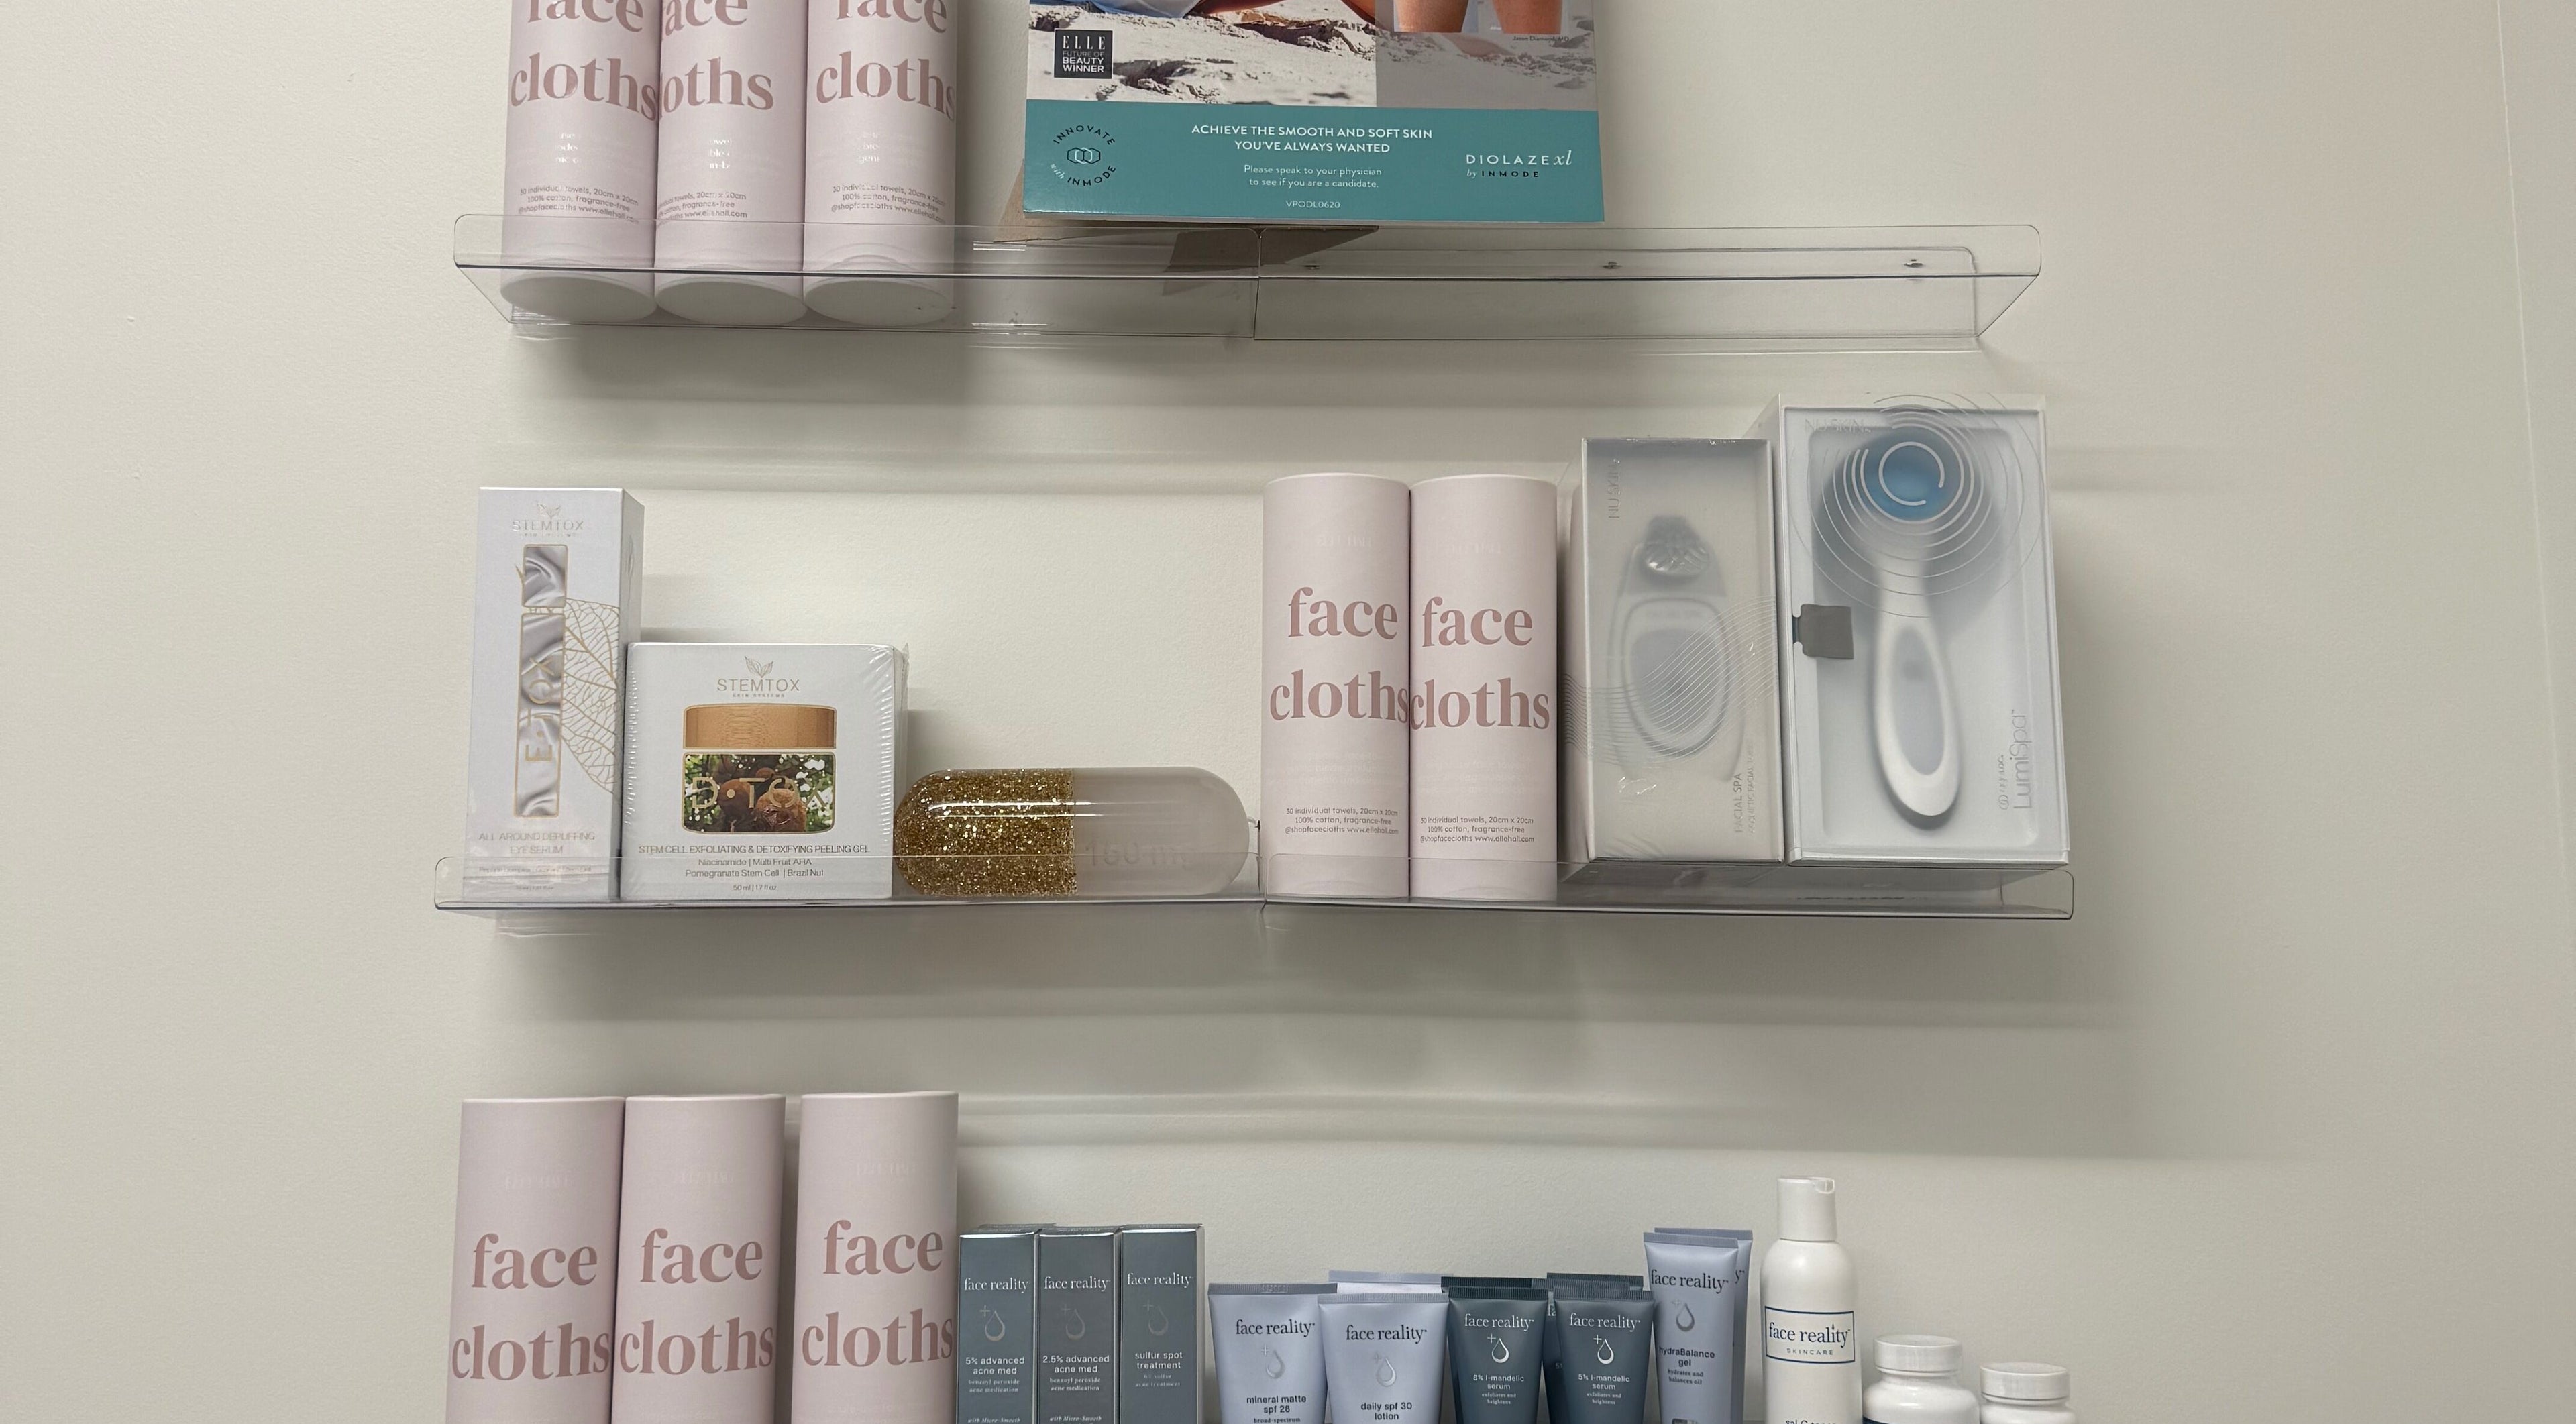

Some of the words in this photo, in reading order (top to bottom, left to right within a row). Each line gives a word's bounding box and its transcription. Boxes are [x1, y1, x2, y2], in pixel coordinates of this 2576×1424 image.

[664, 0, 748, 36] ace
[1063, 35, 1106, 50] ELLE
[1063, 57, 1104, 65] BEAUTY
[1063, 65, 1104, 73] WINNER
[511, 52, 657, 121] cloths
[660, 56, 774, 117] oths
[816, 51, 955, 121] cloths
[1053, 125, 1115, 146] INNOVATE
[1191, 125, 1248, 135] ACHIEVE
[1250, 126, 1275, 135] THE
[1278, 127, 1334, 137] SMOOTH
[1337, 127, 1365, 138] AND
[1368, 129, 1401, 138] SOFT
[1403, 129, 1433, 139] SKIN
[1234, 140, 1281, 150] YOU'VE
[1283, 142, 1333, 152] ALWAYS
[1336, 142, 1391, 152] WANTED
[1067, 165, 1116, 186] INMODE
[1244, 164, 1273, 174] Please
[1275, 166, 1301, 176] speak
[1316, 168, 1337, 177] your
[1339, 166, 1382, 178] physician
[1466, 169, 1477, 179] by
[1279, 178, 1286, 186] if
[1288, 179, 1305, 188] you
[1332, 178, 1379, 188] candidate.
[726, 192, 747, 200] 20cm
[1285, 200, 1340, 209] VPODL0620
[1608, 498, 1620, 518] NU
[511, 519, 584, 531] STEMTOX
[1287, 586, 1398, 640] face
[1421, 596, 1532, 648] face
[716, 678, 800, 692] STEMTOX
[1269, 669, 1408, 723] cloths
[1410, 677, 1550, 730] cloths
[2009, 714, 2033, 809] LumiSpa
[1733, 773, 1743, 793] SPA
[1332, 807, 1358, 815] towels,
[1733, 796, 1743, 833] FACIAL
[1314, 816, 1342, 824] cotton,
[1344, 817, 1392, 826] fragrance-free
[1460, 816, 1487, 824] towels,
[498, 832, 541, 841] AROUND
[1285, 826, 1345, 834] @shopfacecloths
[1346, 826, 1399, 835] www.ellehall.com
[1444, 826, 1470, 834] cotton,
[1472, 826, 1525, 834] fragrance-free
[1420, 835, 1472, 843] @shopfacecloths
[1474, 835, 1535, 843] www.ellehall.com
[529, 845, 564, 855] SERUM
[639, 845, 663, 854] STEM
[665, 845, 688, 854] CELL
[689, 845, 746, 854] EXFOLIATING
[748, 845, 754, 854] &
[756, 844, 813, 854] DETOXIFYING
[814, 845, 851, 854] PEELING
[853, 845, 870, 854] GEL
[1085, 840, 1139, 867] 150
[698, 858, 747, 866] Niacinamide
[753, 858, 771, 866] Multi
[773, 858, 790, 866] Fruit
[792, 858, 812, 866] AHA
[686, 869, 739, 879] Pomegranate
[741, 869, 762, 877] Stem
[764, 869, 780, 877] Cell
[787, 869, 808, 877] Brazil
[810, 869, 824, 877] Nut
[822, 1219, 943, 1275] face
[471, 1233, 598, 1289] face
[640, 1227, 763, 1284] face
[965, 1277, 987, 1291] face
[991, 1277, 1028, 1293] reality
[1044, 1276, 1068, 1289] face
[1127, 1272, 1150, 1285] face
[1651, 1269, 1676, 1286] face
[1680, 1273, 1725, 1294] reality
[1236, 1319, 1263, 1335] face
[1266, 1319, 1313, 1337] reality
[1464, 1313, 1489, 1327] face
[1492, 1314, 1530, 1331] reality
[1570, 1312, 1595, 1327] face
[1597, 1314, 1638, 1332] reality
[802, 1307, 953, 1368] cloths
[1346, 1324, 1375, 1341] face
[1378, 1324, 1424, 1344] reality
[1769, 1322, 1795, 1341] face
[1799, 1323, 1848, 1348] reality
[452, 1322, 610, 1381] cloths
[619, 1316, 774, 1376] cloths
[1658, 1345, 1715, 1358] hydraBalance
[1786, 1348, 1833, 1356] SKINCARE
[966, 1357, 978, 1365] 5%
[981, 1356, 1025, 1364] advanced
[1042, 1355, 1063, 1363] 2.5%
[1066, 1355, 1110, 1363] advanced
[1135, 1351, 1159, 1359] sulfur
[1163, 1352, 1183, 1360] spot
[1078, 1365, 1098, 1373] med
[1678, 1358, 1692, 1368] gel
[1667, 1368, 1691, 1376] hydrates
[1668, 1376, 1693, 1384] balances
[1246, 1395, 1279, 1404] mineral
[1281, 1395, 1307, 1403] matte
[1263, 1405, 1277, 1415] spf
[1279, 1405, 1291, 1413] 28
[1360, 1402, 1382, 1412] daily
[1384, 1402, 1398, 1412] spf
[1401, 1401, 1413, 1410] 30
[1375, 1412, 1399, 1420] lotion
